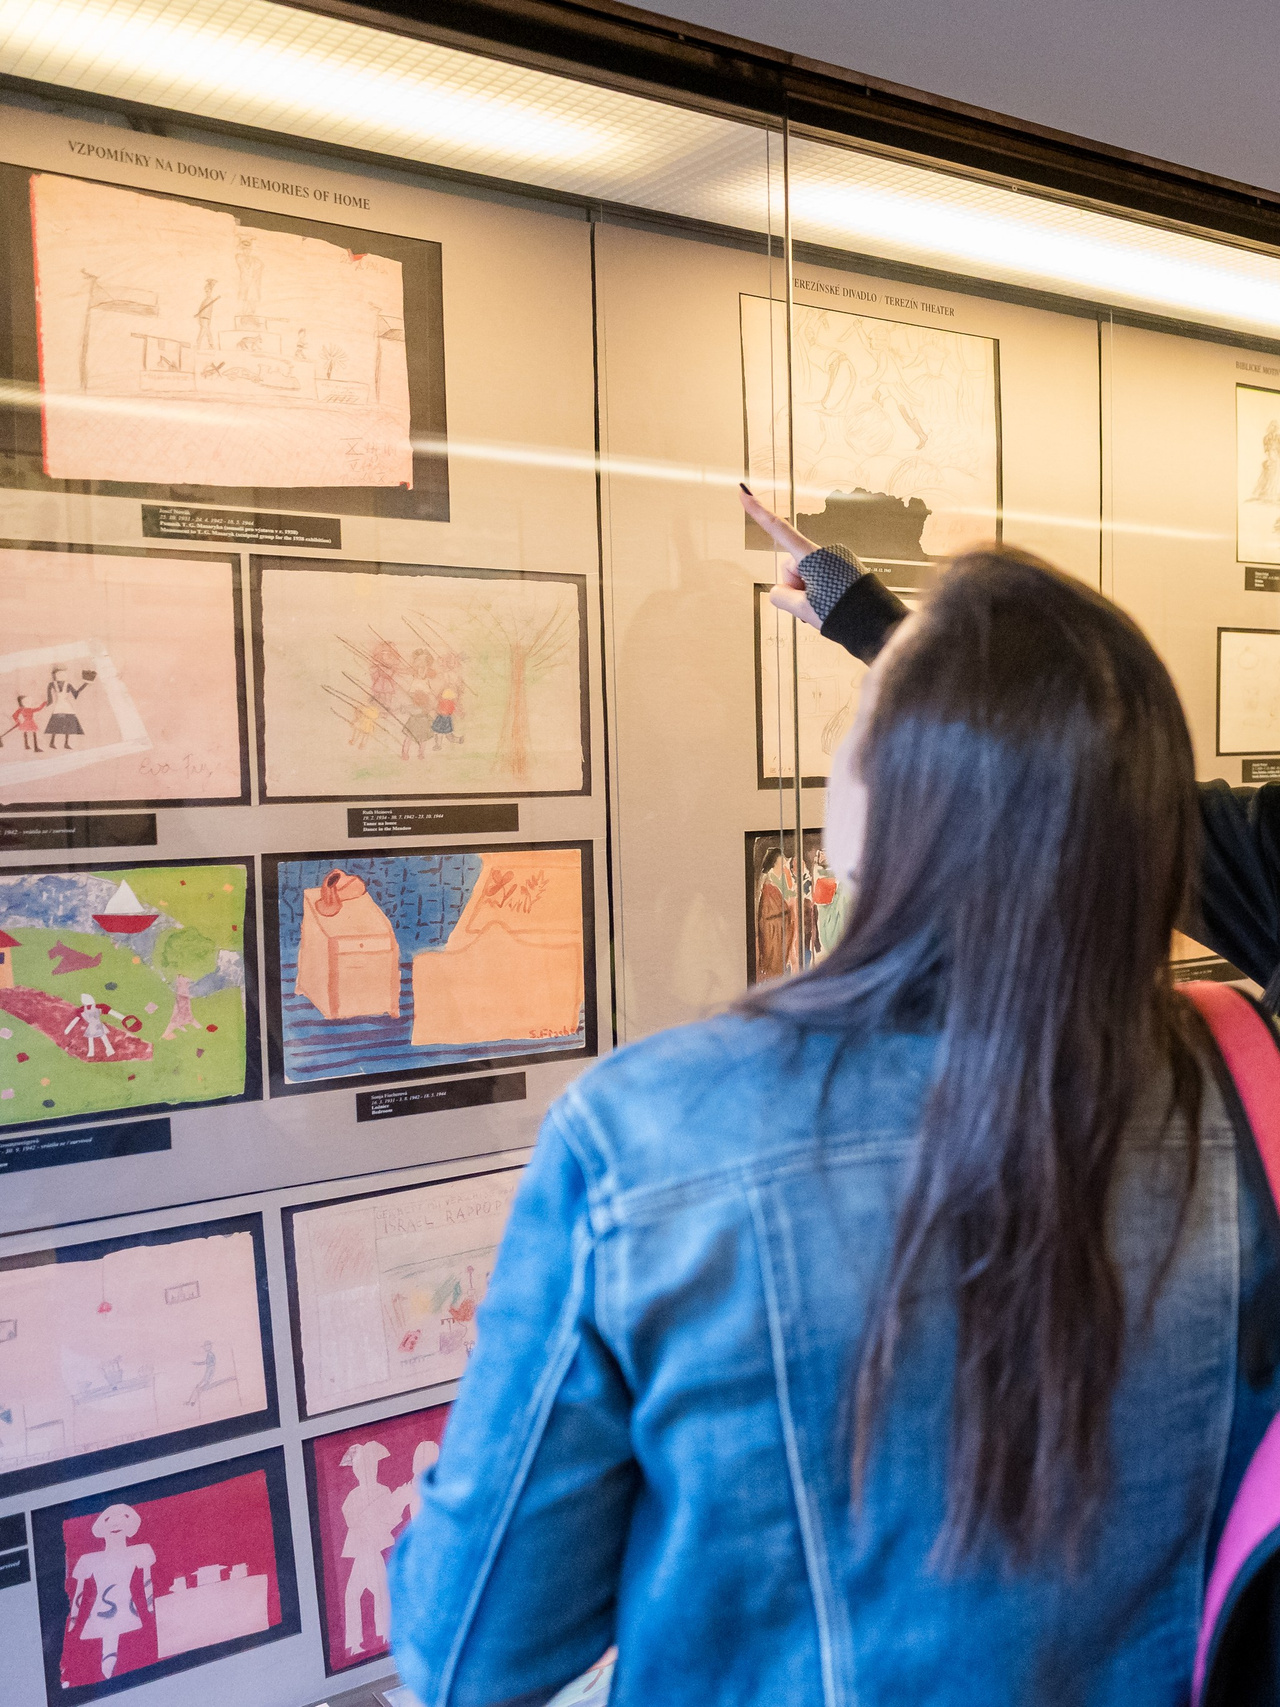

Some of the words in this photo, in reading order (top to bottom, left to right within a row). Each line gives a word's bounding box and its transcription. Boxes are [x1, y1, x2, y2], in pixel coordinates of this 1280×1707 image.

[68, 140, 152, 168] VZPOMÍNKY
[155, 157, 174, 172] NA
[177, 162, 227, 182] DOMOV
[240, 174, 309, 199] MEMORIES
[313, 189, 330, 202] OF
[334, 192, 371, 210] HOME
[843, 287, 877, 303] DIVADLO
[885, 295, 919, 310] TEREZÍN
[920, 302, 955, 317] THEATER
